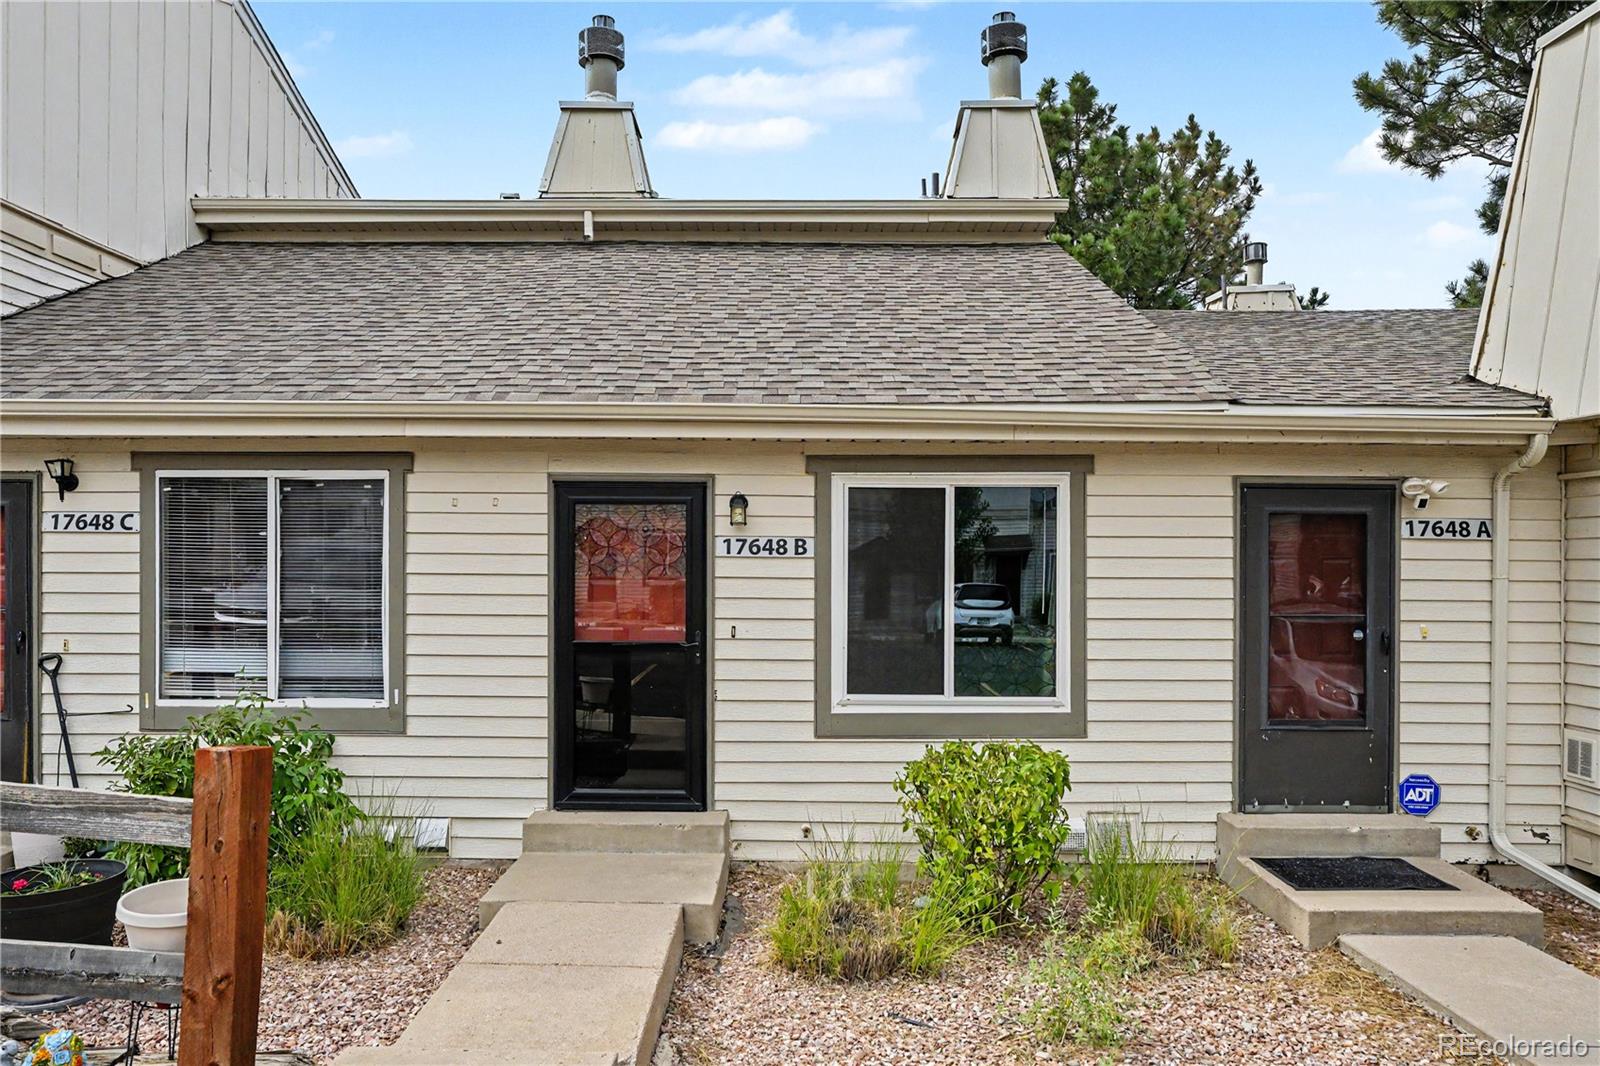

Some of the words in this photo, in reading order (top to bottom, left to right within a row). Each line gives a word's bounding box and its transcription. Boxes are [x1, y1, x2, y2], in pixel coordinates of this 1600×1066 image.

[51, 514, 115, 531] 17648
[120, 513, 135, 531] C
[1405, 520, 1471, 538] 17648
[1476, 521, 1492, 538] A
[723, 538, 788, 556] 17648
[794, 538, 808, 556] B
[1405, 787, 1434, 802] ADT
